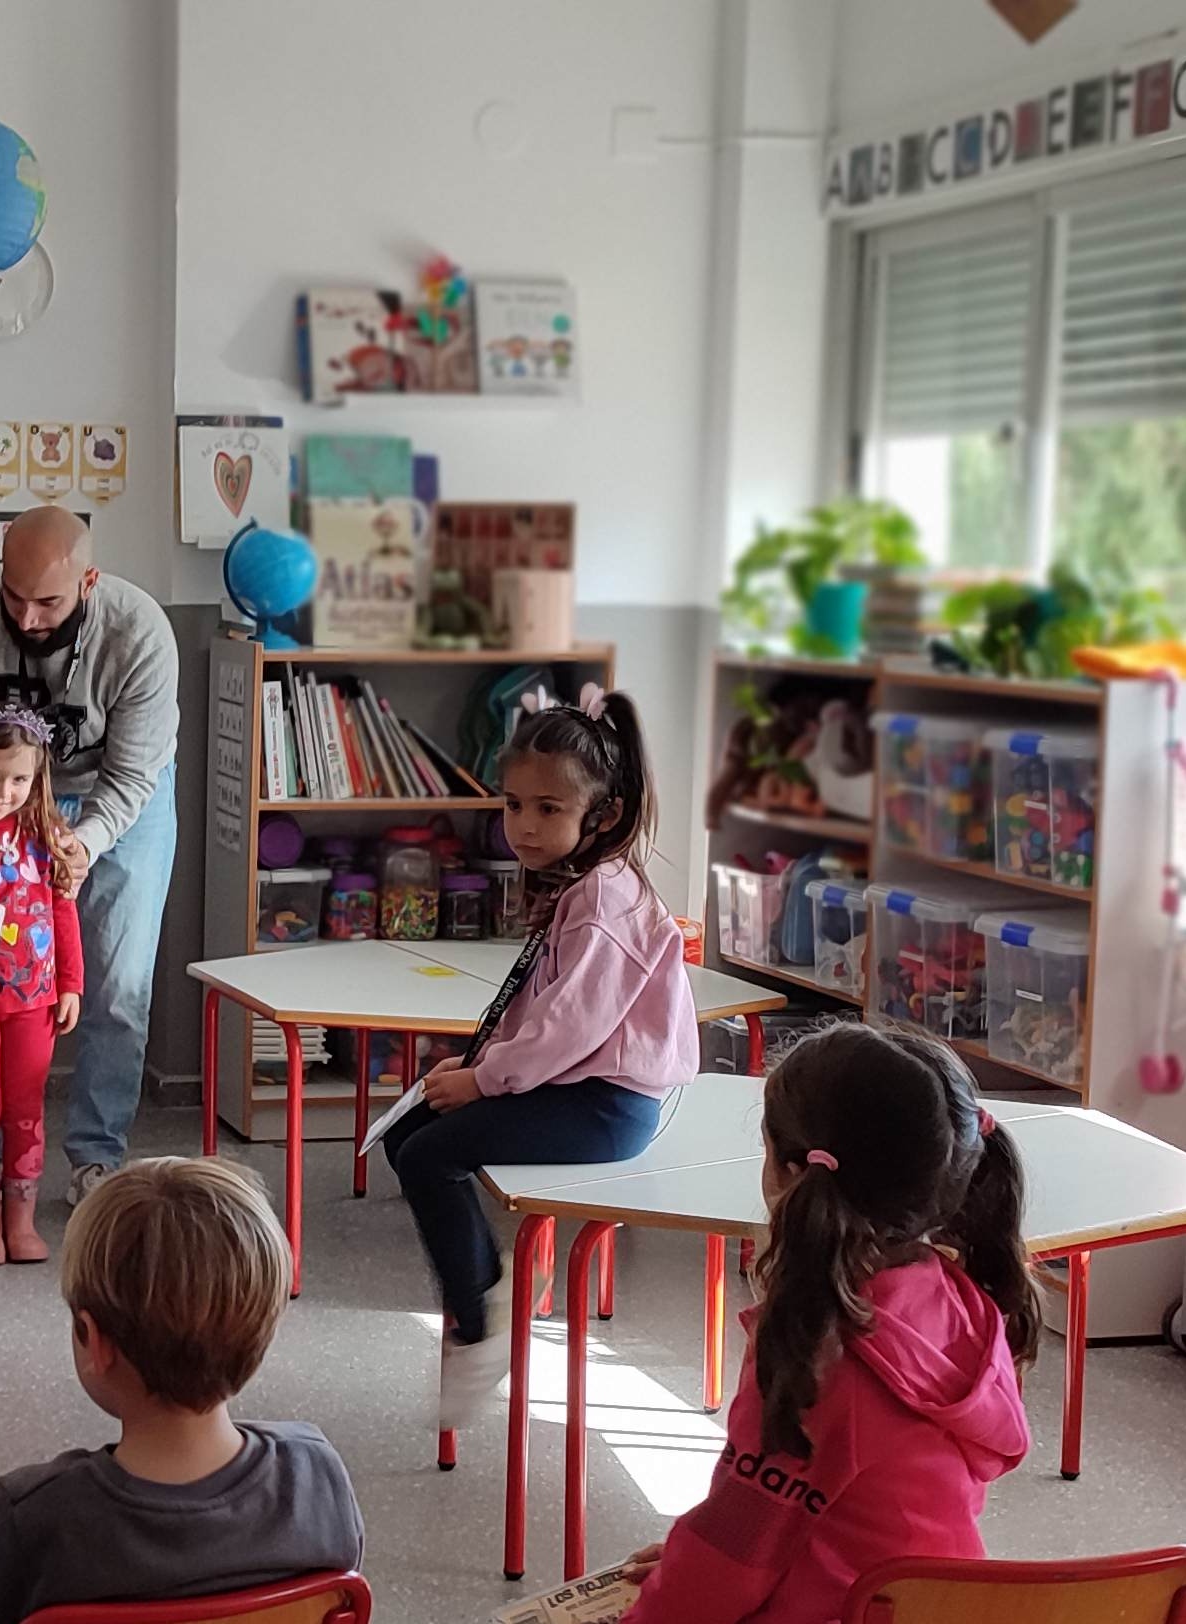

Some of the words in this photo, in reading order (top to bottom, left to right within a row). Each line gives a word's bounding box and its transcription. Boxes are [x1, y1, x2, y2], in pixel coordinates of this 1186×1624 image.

[927, 126, 949, 185] C
[988, 110, 1012, 168] D
[1046, 86, 1068, 156] E
[1110, 69, 1133, 143] F
